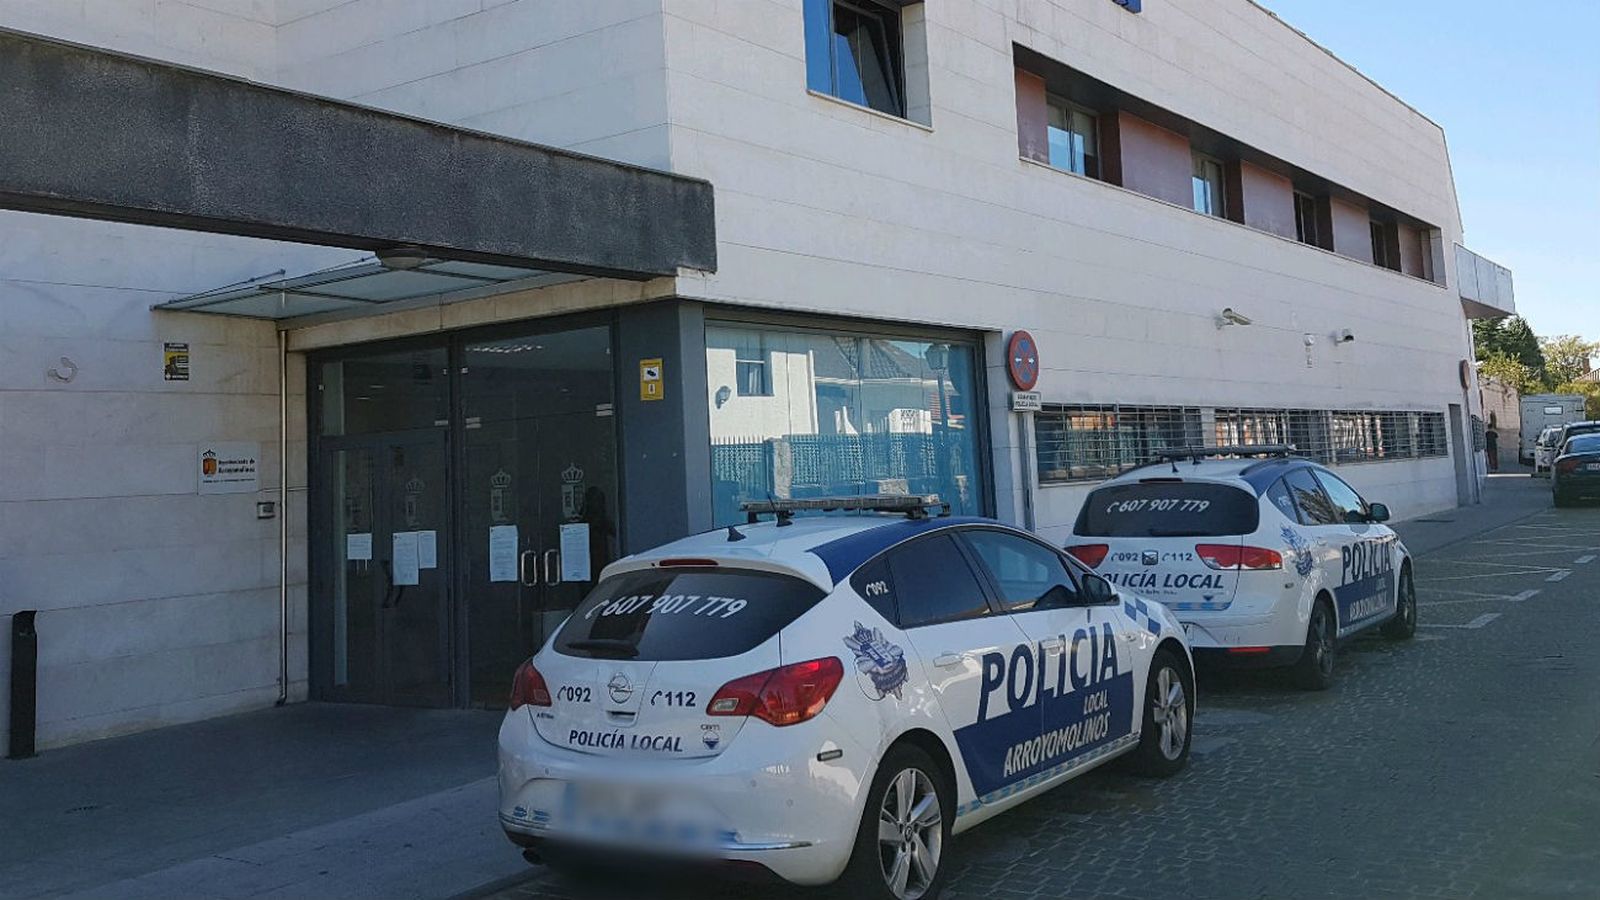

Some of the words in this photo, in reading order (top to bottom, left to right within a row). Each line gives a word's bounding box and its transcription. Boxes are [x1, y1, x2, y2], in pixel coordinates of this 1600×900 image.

[1119, 501, 1148, 512] 607
[1149, 499, 1179, 511] 907
[1180, 500, 1210, 513] 779
[1119, 552, 1138, 561] 092
[1171, 552, 1193, 561] 112
[1163, 574, 1224, 589] LOCAL
[602, 595, 652, 616] 607
[646, 595, 701, 614] 907
[694, 597, 748, 618] 779
[977, 609, 1118, 724] POLICÍA
[566, 687, 591, 703] 092
[664, 691, 696, 707] 112
[1083, 690, 1109, 714] LOCAL
[569, 729, 625, 750] POLICÍA
[631, 735, 683, 752] LOCAL
[1003, 712, 1111, 778] ARROYOMOLINOS
